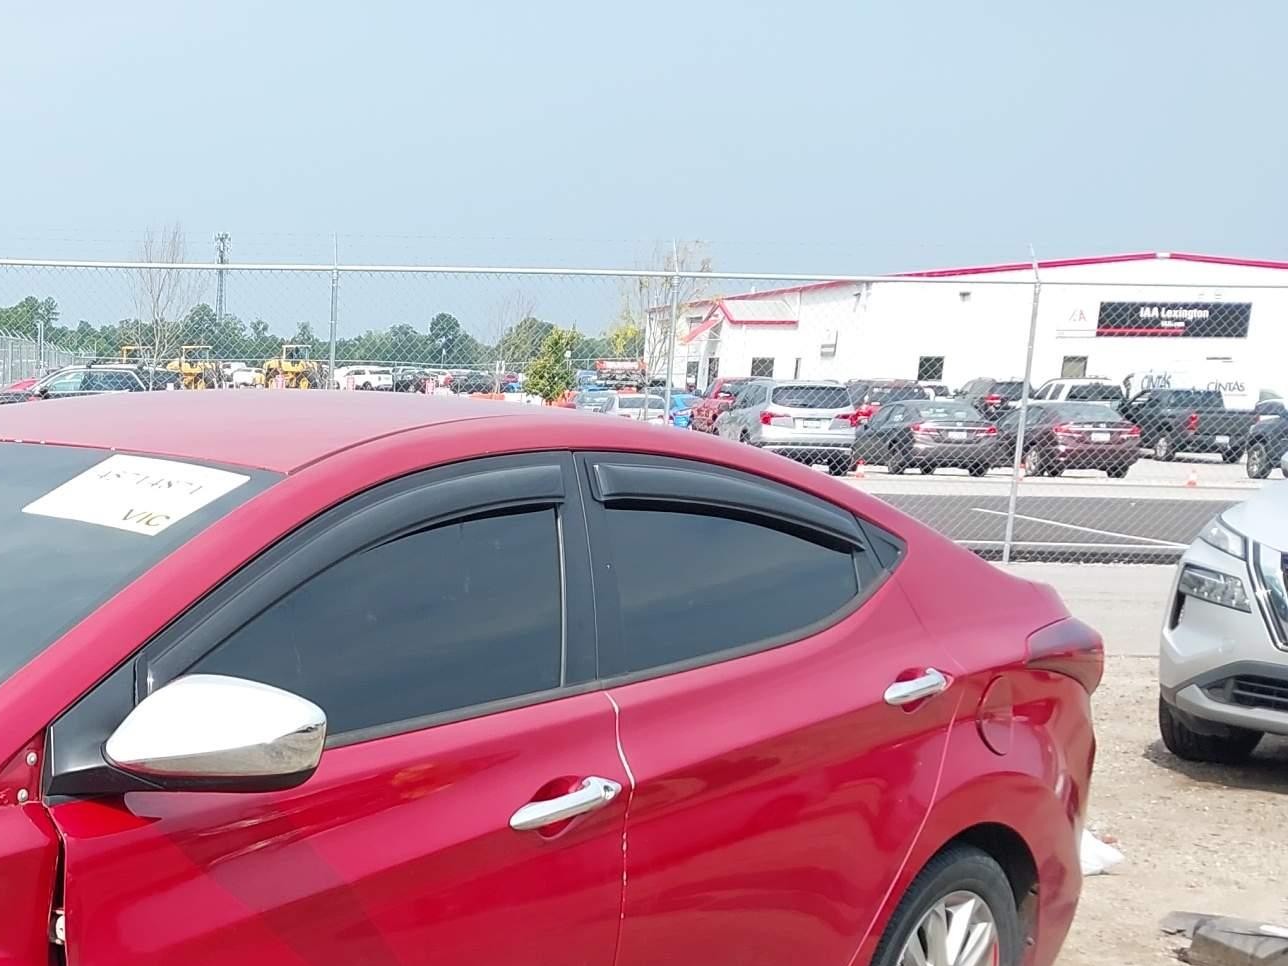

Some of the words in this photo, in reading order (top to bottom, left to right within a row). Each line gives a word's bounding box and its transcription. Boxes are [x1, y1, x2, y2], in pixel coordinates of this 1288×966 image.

[1140, 307, 1158, 317] IAA
[1161, 307, 1209, 319] Lexington
[1207, 380, 1245, 392] CINTAS
[122, 509, 170, 527] VIC
